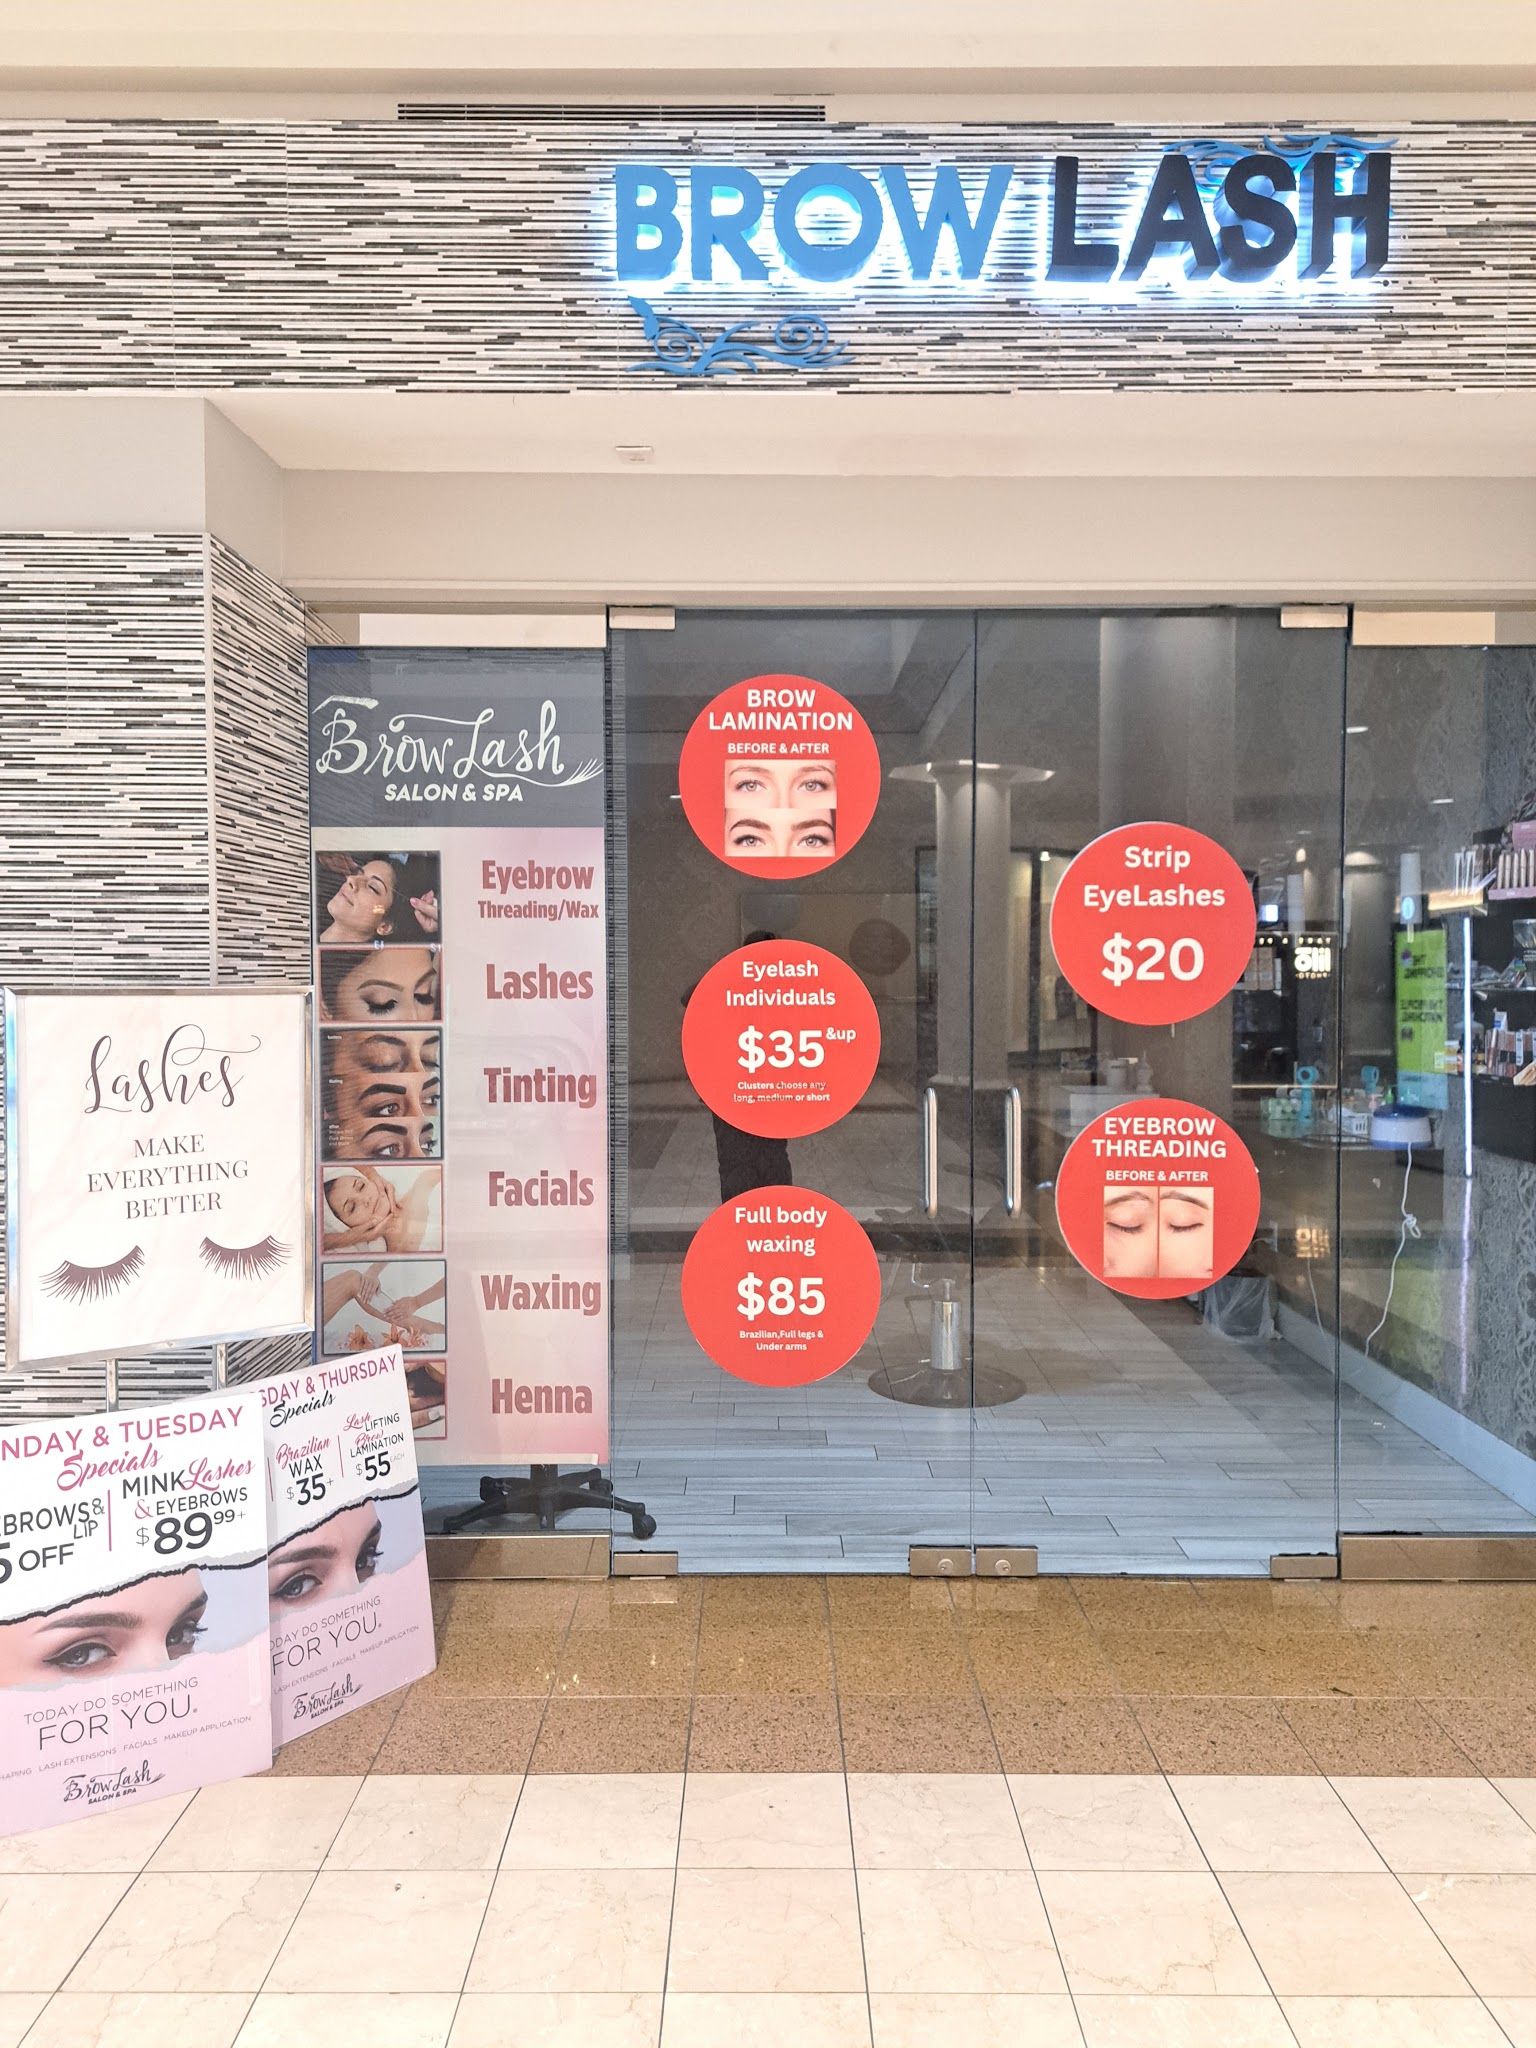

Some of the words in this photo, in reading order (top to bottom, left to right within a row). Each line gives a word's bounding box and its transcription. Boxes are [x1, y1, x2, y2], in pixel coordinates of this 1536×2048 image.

[615, 163, 1014, 282] BROW
[1047, 152, 1391, 281] LASH
[747, 689, 816, 708] BROW
[709, 712, 853, 731] LAMINATION
[316, 708, 453, 778] Brow
[452, 699, 570, 785] Lash
[727, 743, 776, 754] BEFORE
[778, 743, 788, 754] &
[791, 743, 830, 754] AFTER
[384, 783, 458, 801] SALON
[462, 783, 476, 801] &
[482, 783, 523, 801] SPA
[1124, 844, 1191, 874] Strip
[482, 860, 594, 895] Eyebrow
[478, 900, 600, 922] Threading/Wax
[1083, 884, 1226, 913] EyeLashes
[742, 960, 819, 982] Eyelash
[1101, 932, 1205, 987] $20
[486, 963, 594, 1000] Lashes
[726, 988, 836, 1006] Individuals
[737, 1025, 825, 1073] $35
[84, 1024, 261, 1114] Lashes
[484, 1066, 598, 1109] Tinting
[734, 1093, 756, 1104] long,
[757, 1094, 794, 1103] medium
[806, 1093, 831, 1102] short
[737, 1081, 774, 1090] Clusters
[776, 1081, 808, 1090] choose
[810, 1082, 826, 1092] any
[1105, 1117, 1216, 1136] EYEBROW
[134, 1133, 205, 1159] MAKE
[1092, 1139, 1227, 1158] THREADING
[87, 1159, 249, 1193] EVERYTHING
[489, 1170, 595, 1207] Facials
[1106, 1170, 1155, 1181] BEFORE
[1157, 1171, 1166, 1181] &
[1168, 1171, 1209, 1181] AFTER
[126, 1192, 223, 1220] BETTER
[735, 1207, 772, 1224] Full
[776, 1206, 827, 1227] body
[746, 1235, 816, 1257] waxing
[480, 1273, 602, 1316] Waxing
[736, 1272, 826, 1321] $85
[756, 1342, 783, 1351] Under
[798, 1330, 816, 1340] legs
[818, 1330, 824, 1339] &
[305, 1376, 316, 1395] &
[318, 1353, 397, 1390] THURSDAY
[269, 1389, 335, 1429] Specials
[491, 1378, 593, 1414] Henna
[1, 1428, 83, 1461] NDAY
[93, 1425, 110, 1448] &
[119, 1405, 243, 1443] TUESDAY
[343, 1412, 371, 1432] Lash
[365, 1412, 401, 1432] LIFTING
[275, 1435, 331, 1470] Brazilian
[350, 1432, 405, 1458] LAMINATION
[56, 1441, 164, 1491] Specials
[122, 1469, 186, 1500] MINK
[181, 1456, 255, 1492] Lashes
[288, 1454, 323, 1479] WAX
[355, 1450, 391, 1482] $55
[134, 1498, 154, 1520] &
[155, 1486, 248, 1516] EYEBROWS
[73, 1519, 99, 1540] LIP
[18, 1543, 75, 1572] OFF
[302, 1621, 319, 1637] DO
[320, 1595, 382, 1630] SOMETHING
[272, 1636, 323, 1676] FOR
[24, 1703, 79, 1725] TODAY
[84, 1697, 107, 1712] DO
[112, 1676, 199, 1706] SOMETHING
[292, 1694, 327, 1720] Brow
[326, 1673, 354, 1706] Lash
[38, 1760, 62, 1772] LASH
[63, 1747, 117, 1766] EXTENSIONS
[123, 1737, 158, 1752] FACIALS
[164, 1728, 198, 1742] MAKEUP
[199, 1715, 252, 1733] APPLICATION
[39, 1713, 109, 1750] FOR
[63, 1778, 113, 1802] Brow
[111, 1759, 152, 1791] Lash
[88, 1793, 114, 1804] SALON
[122, 1787, 138, 1799] SPA
